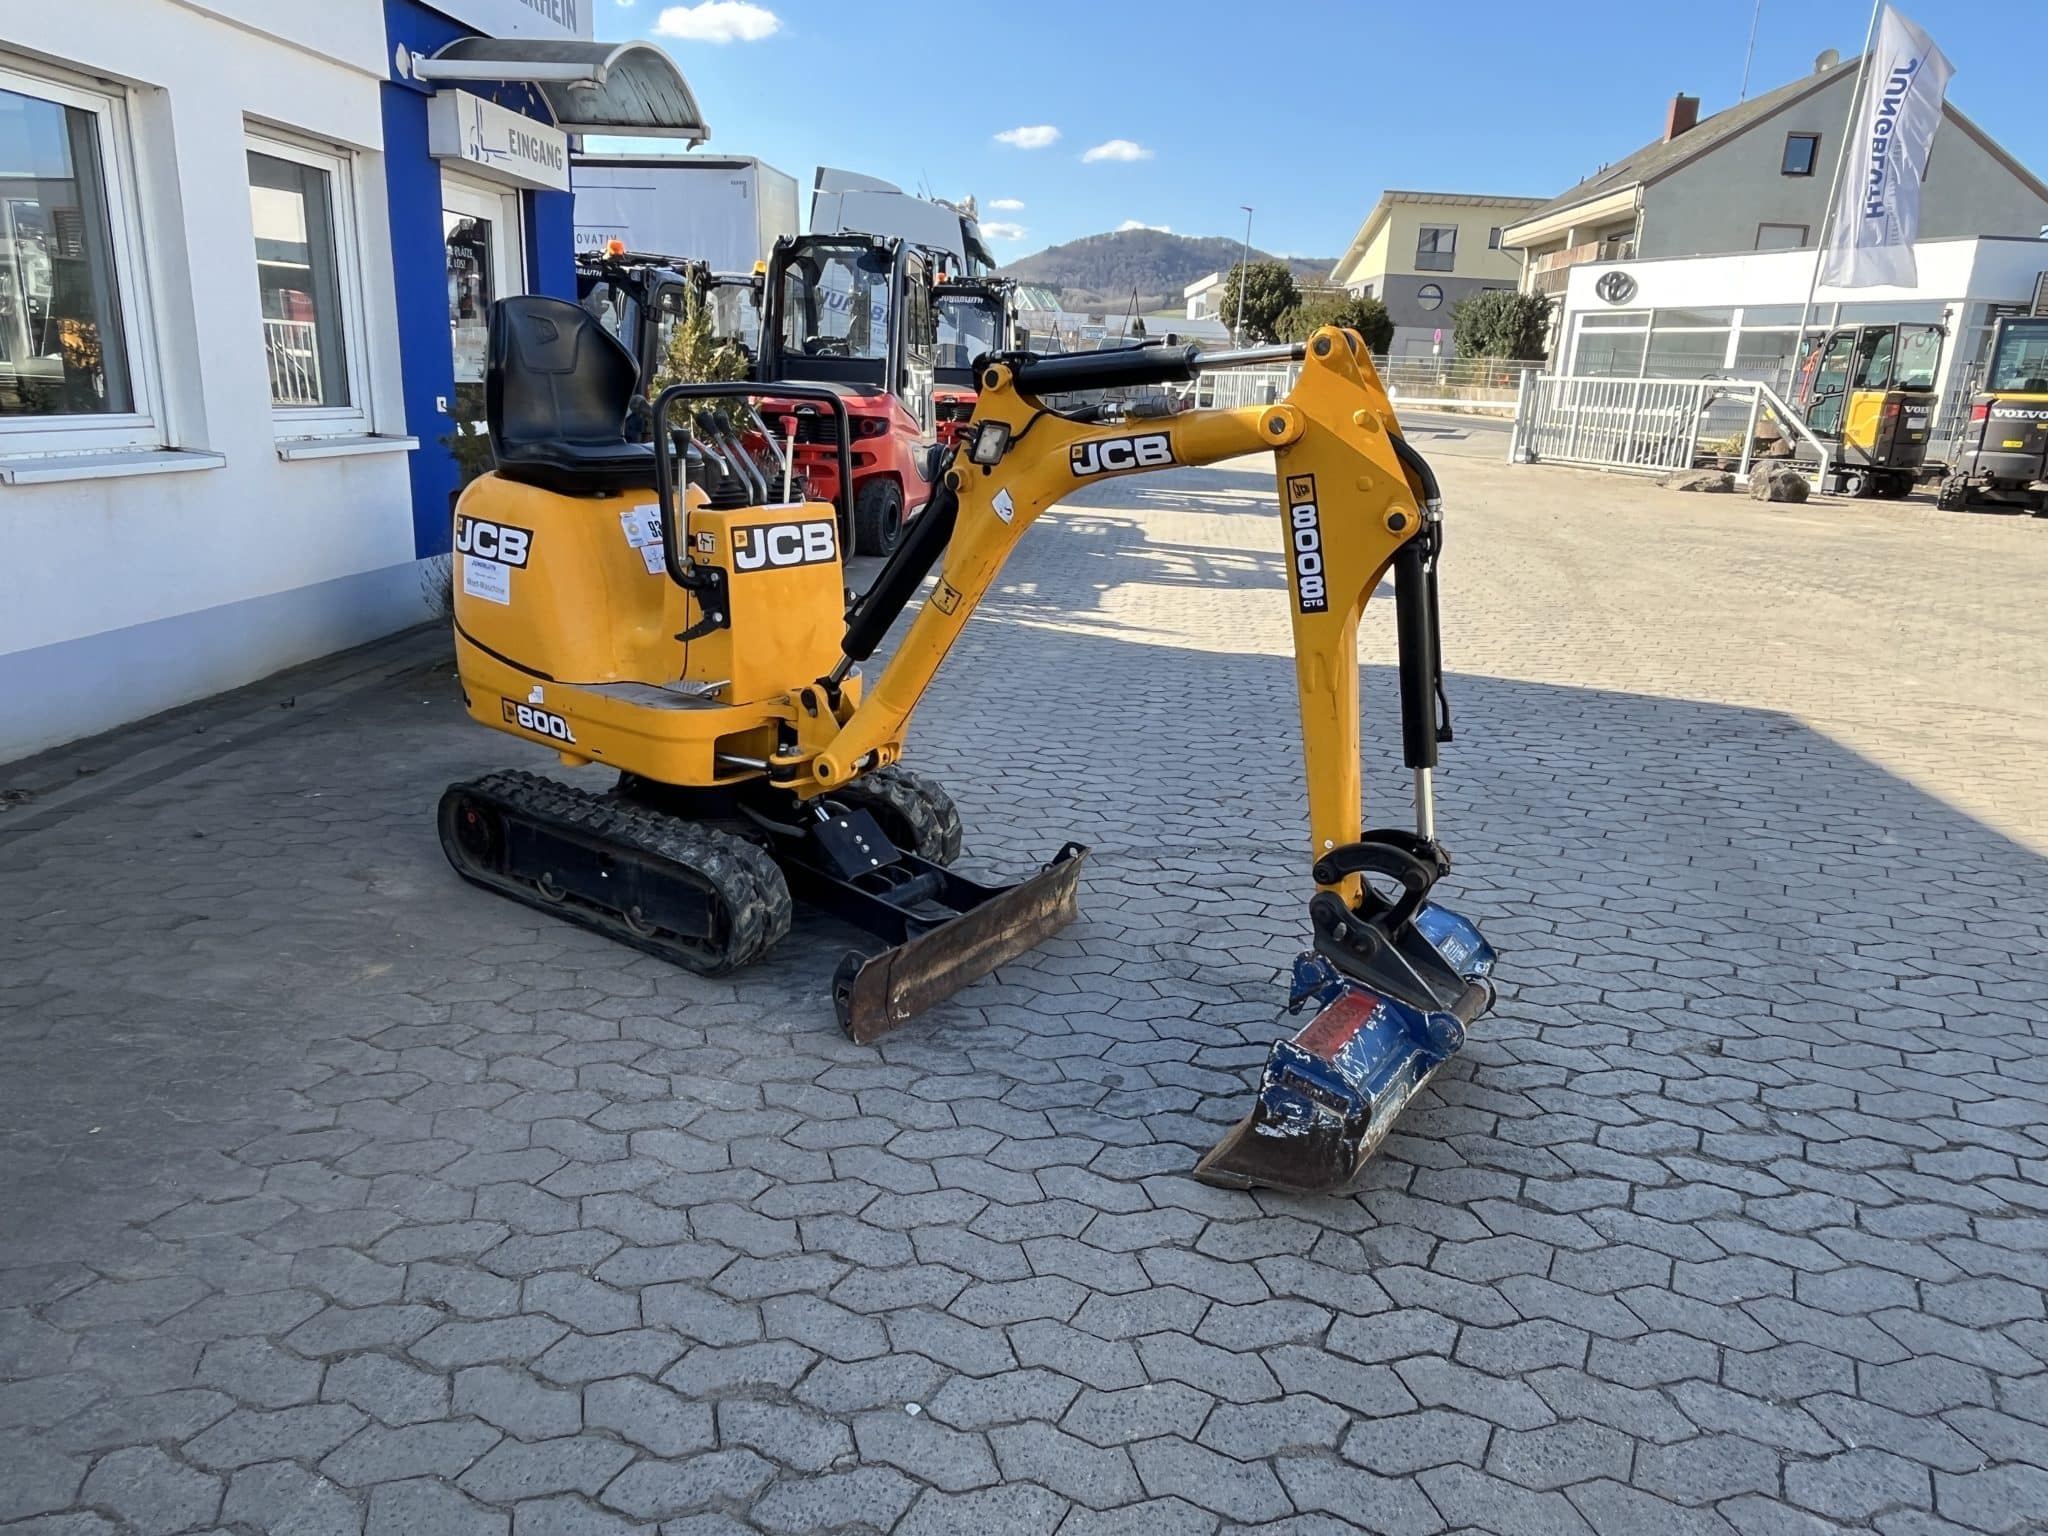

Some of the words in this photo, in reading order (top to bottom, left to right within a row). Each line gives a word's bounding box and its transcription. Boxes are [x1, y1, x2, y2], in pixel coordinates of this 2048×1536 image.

[508, 128, 563, 171] EINGANG
[1991, 408, 2048, 420] VOLVO
[1072, 435, 1173, 476] JCB
[457, 519, 529, 565] JCB
[735, 522, 836, 569] JCB
[1292, 504, 1325, 599] 8008
